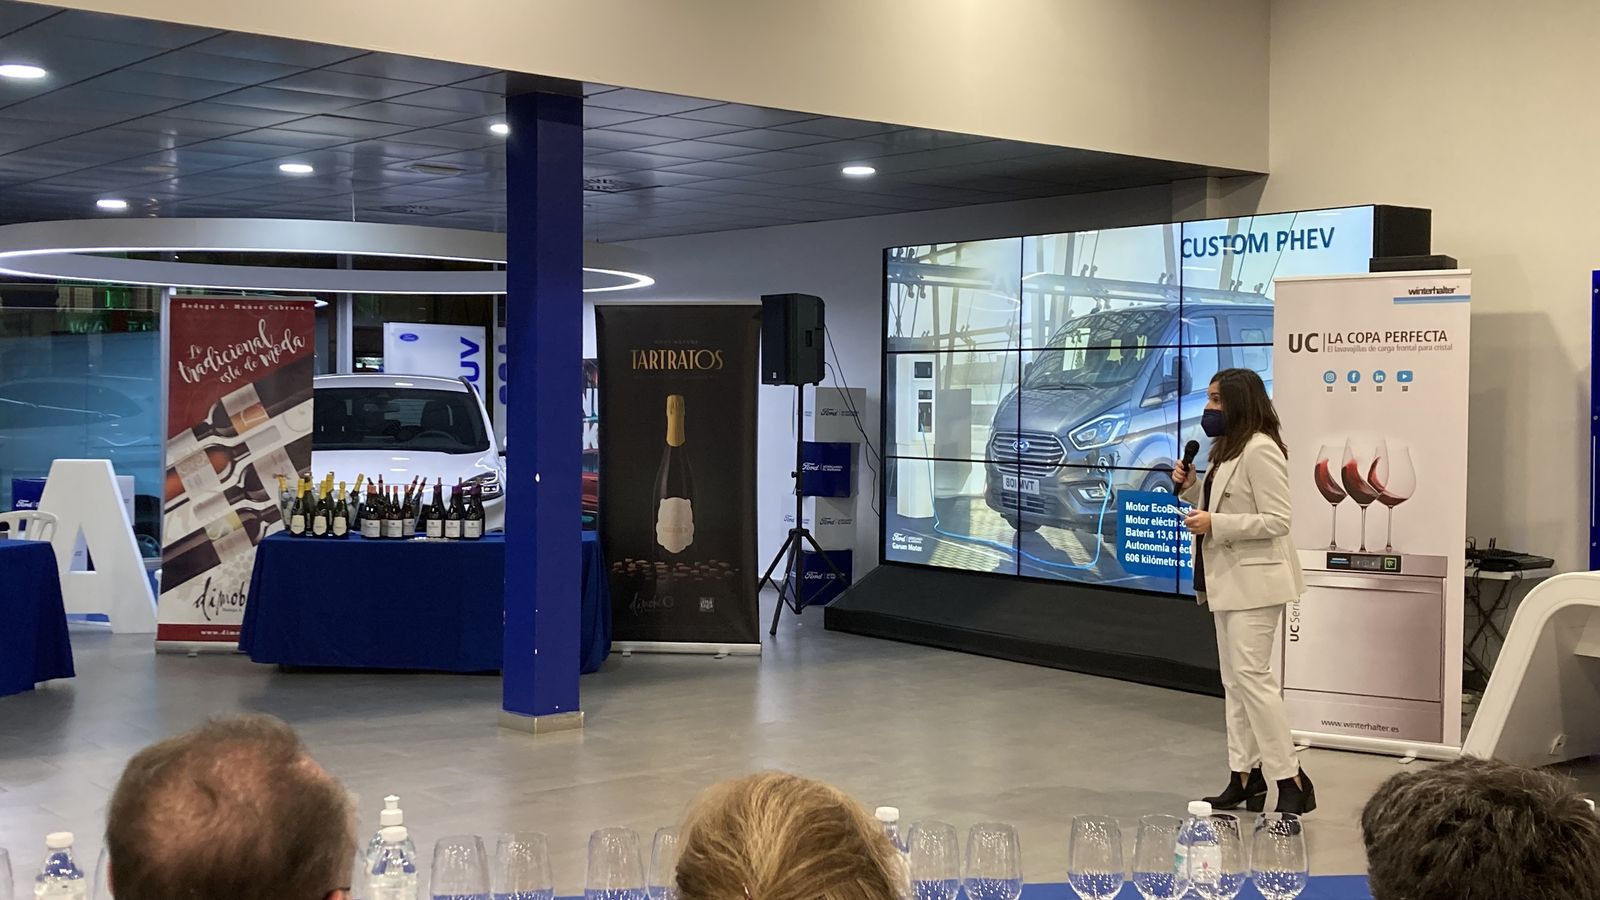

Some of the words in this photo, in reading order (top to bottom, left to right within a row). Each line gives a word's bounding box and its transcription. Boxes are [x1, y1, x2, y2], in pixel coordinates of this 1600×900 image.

[1182, 232, 1269, 258] CUSTOM
[1276, 227, 1335, 251] PHEV
[1408, 285, 1456, 295] winterhalter
[1288, 332, 1319, 353] UC
[1328, 332, 1343, 344] LA
[1347, 331, 1381, 344] COPA
[1385, 330, 1448, 343] PERFECTA
[178, 319, 273, 383] tradicional
[1368, 344, 1376, 352] de
[1377, 345, 1395, 353] carga
[1396, 344, 1417, 352] frontal
[1418, 345, 1433, 353] para
[1434, 343, 1453, 351] cristal
[244, 358, 257, 372] de
[460, 336, 480, 393] UV
[630, 349, 723, 369] TARTRATOS
[802, 462, 819, 472] Ford
[1125, 502, 1149, 512] Motor
[1151, 503, 1193, 514] EcoBost
[1125, 515, 1149, 525] Motor
[1151, 516, 1187, 527] eléctrio
[1125, 527, 1154, 538] Batería
[1156, 530, 1173, 541] 13,6
[1125, 540, 1170, 552] Autonomía
[1125, 553, 1140, 562] 606
[1290, 625, 1300, 642] UC
[1321, 720, 1399, 733] www.winterhalter.es
